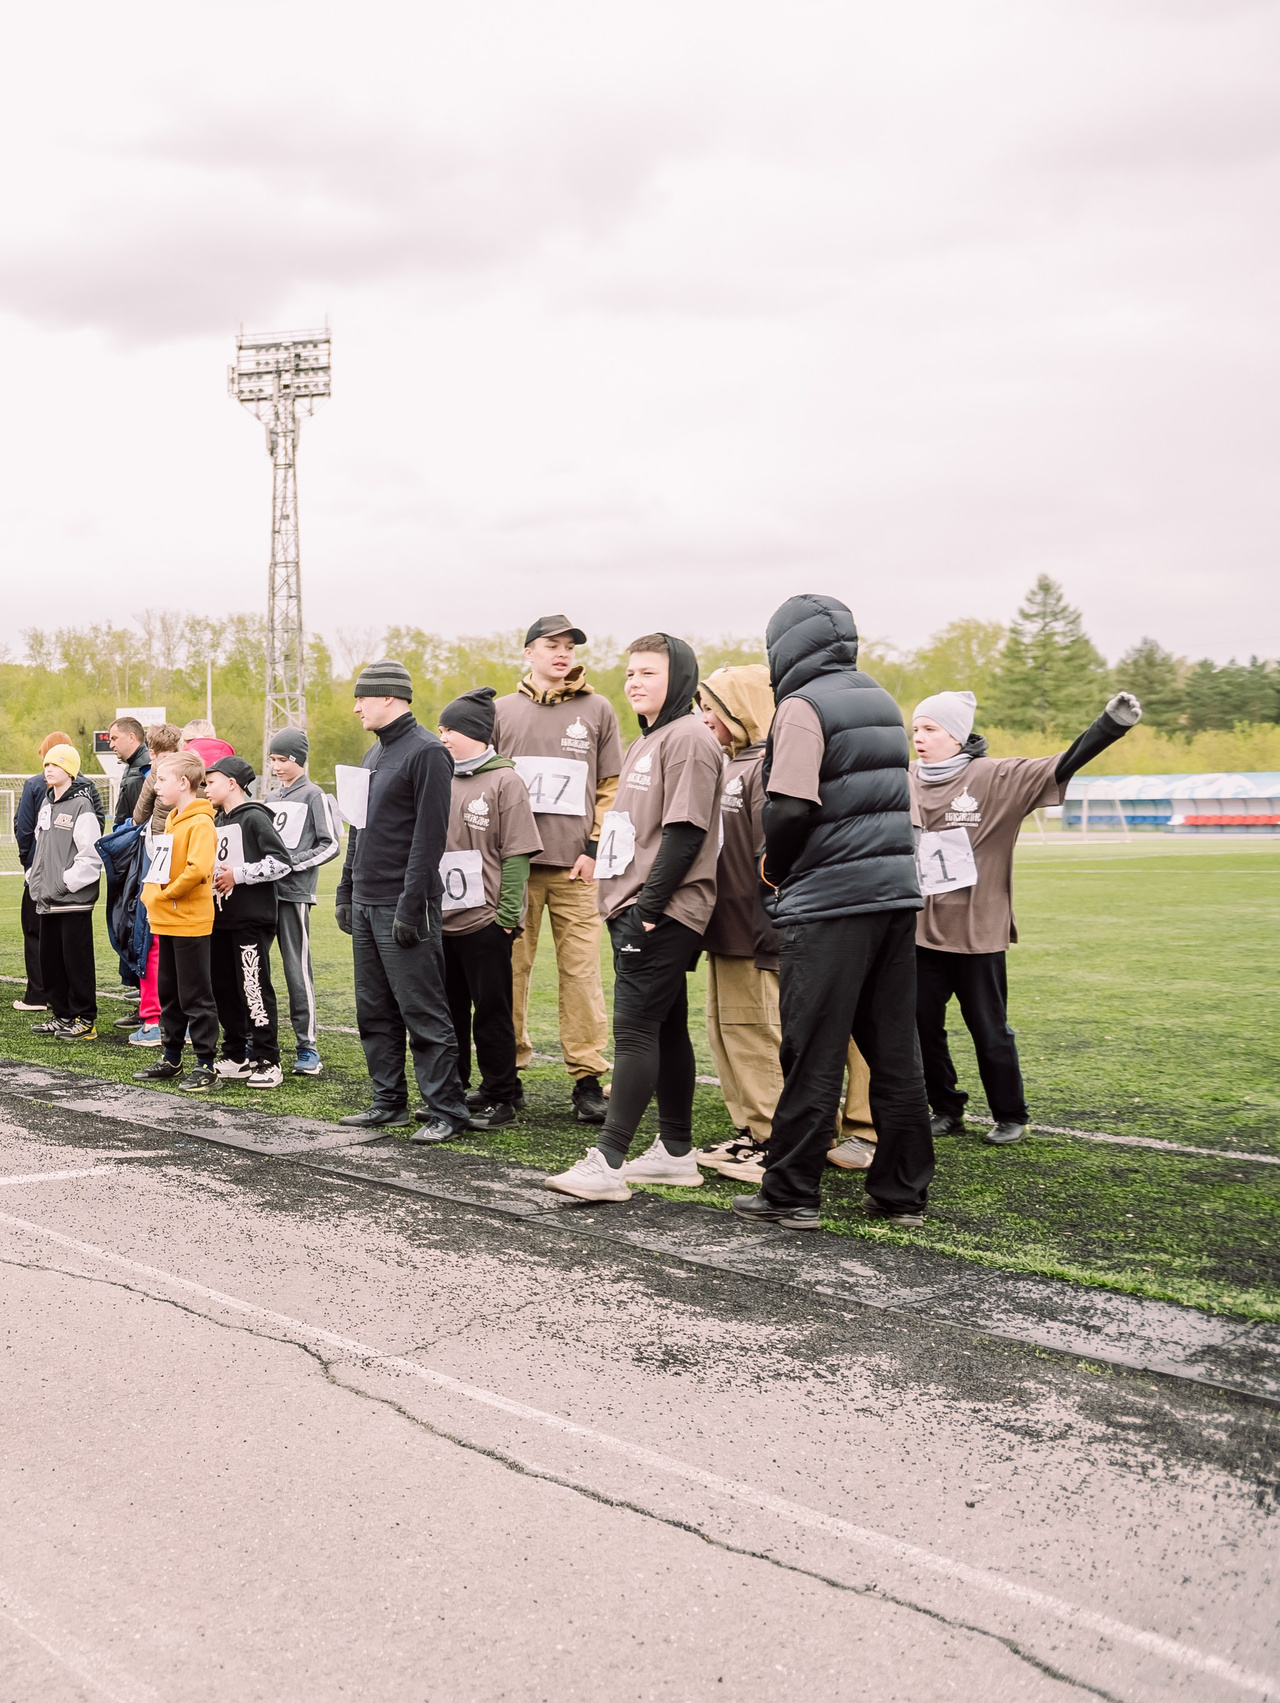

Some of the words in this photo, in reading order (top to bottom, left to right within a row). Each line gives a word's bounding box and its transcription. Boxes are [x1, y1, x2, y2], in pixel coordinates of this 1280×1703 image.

[527, 772, 572, 805] 47
[151, 846, 170, 872] 77
[217, 836, 229, 862] 8
[599, 829, 618, 868] 4
